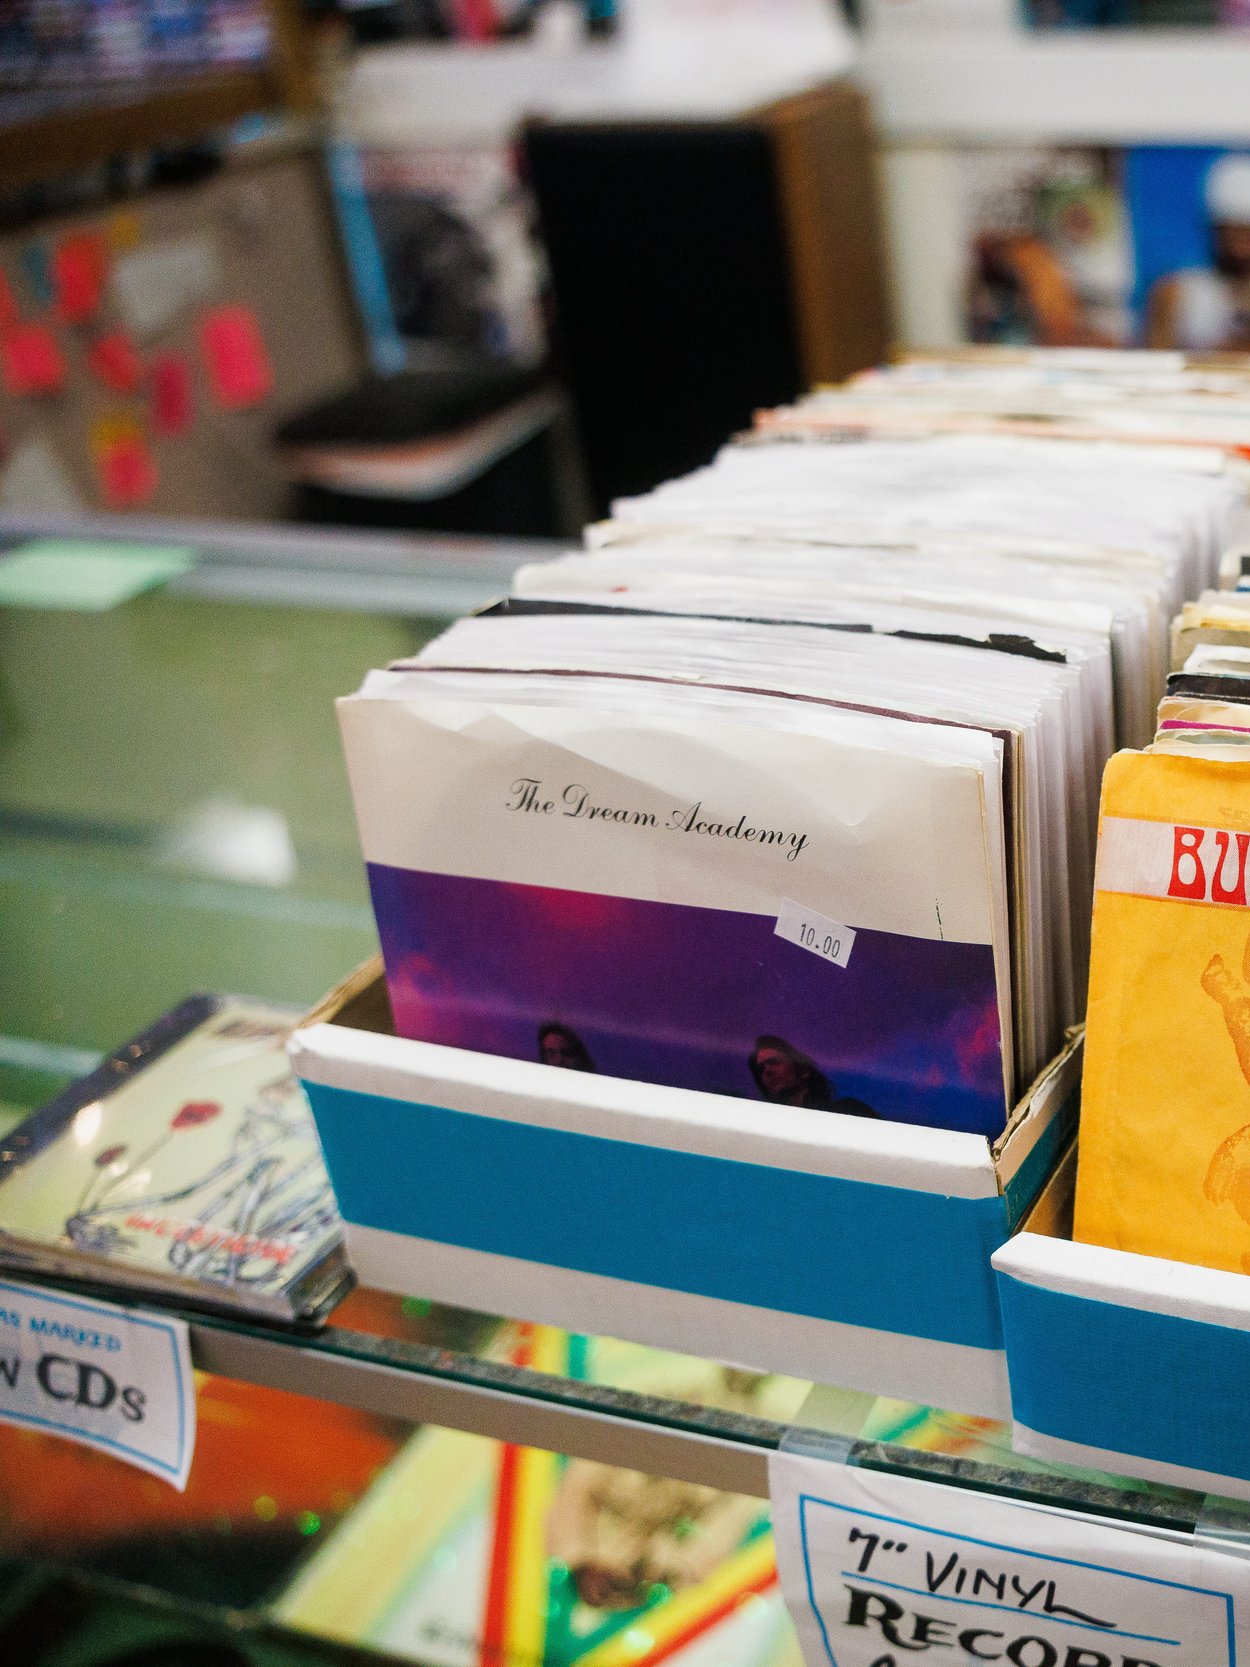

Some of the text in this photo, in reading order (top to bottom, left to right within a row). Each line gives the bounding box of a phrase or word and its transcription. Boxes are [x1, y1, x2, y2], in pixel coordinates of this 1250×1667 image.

[505, 778, 810, 862] The Dream Academy
[800, 923, 841, 959] 10.00
[926, 1550, 1118, 1628] VINYL
